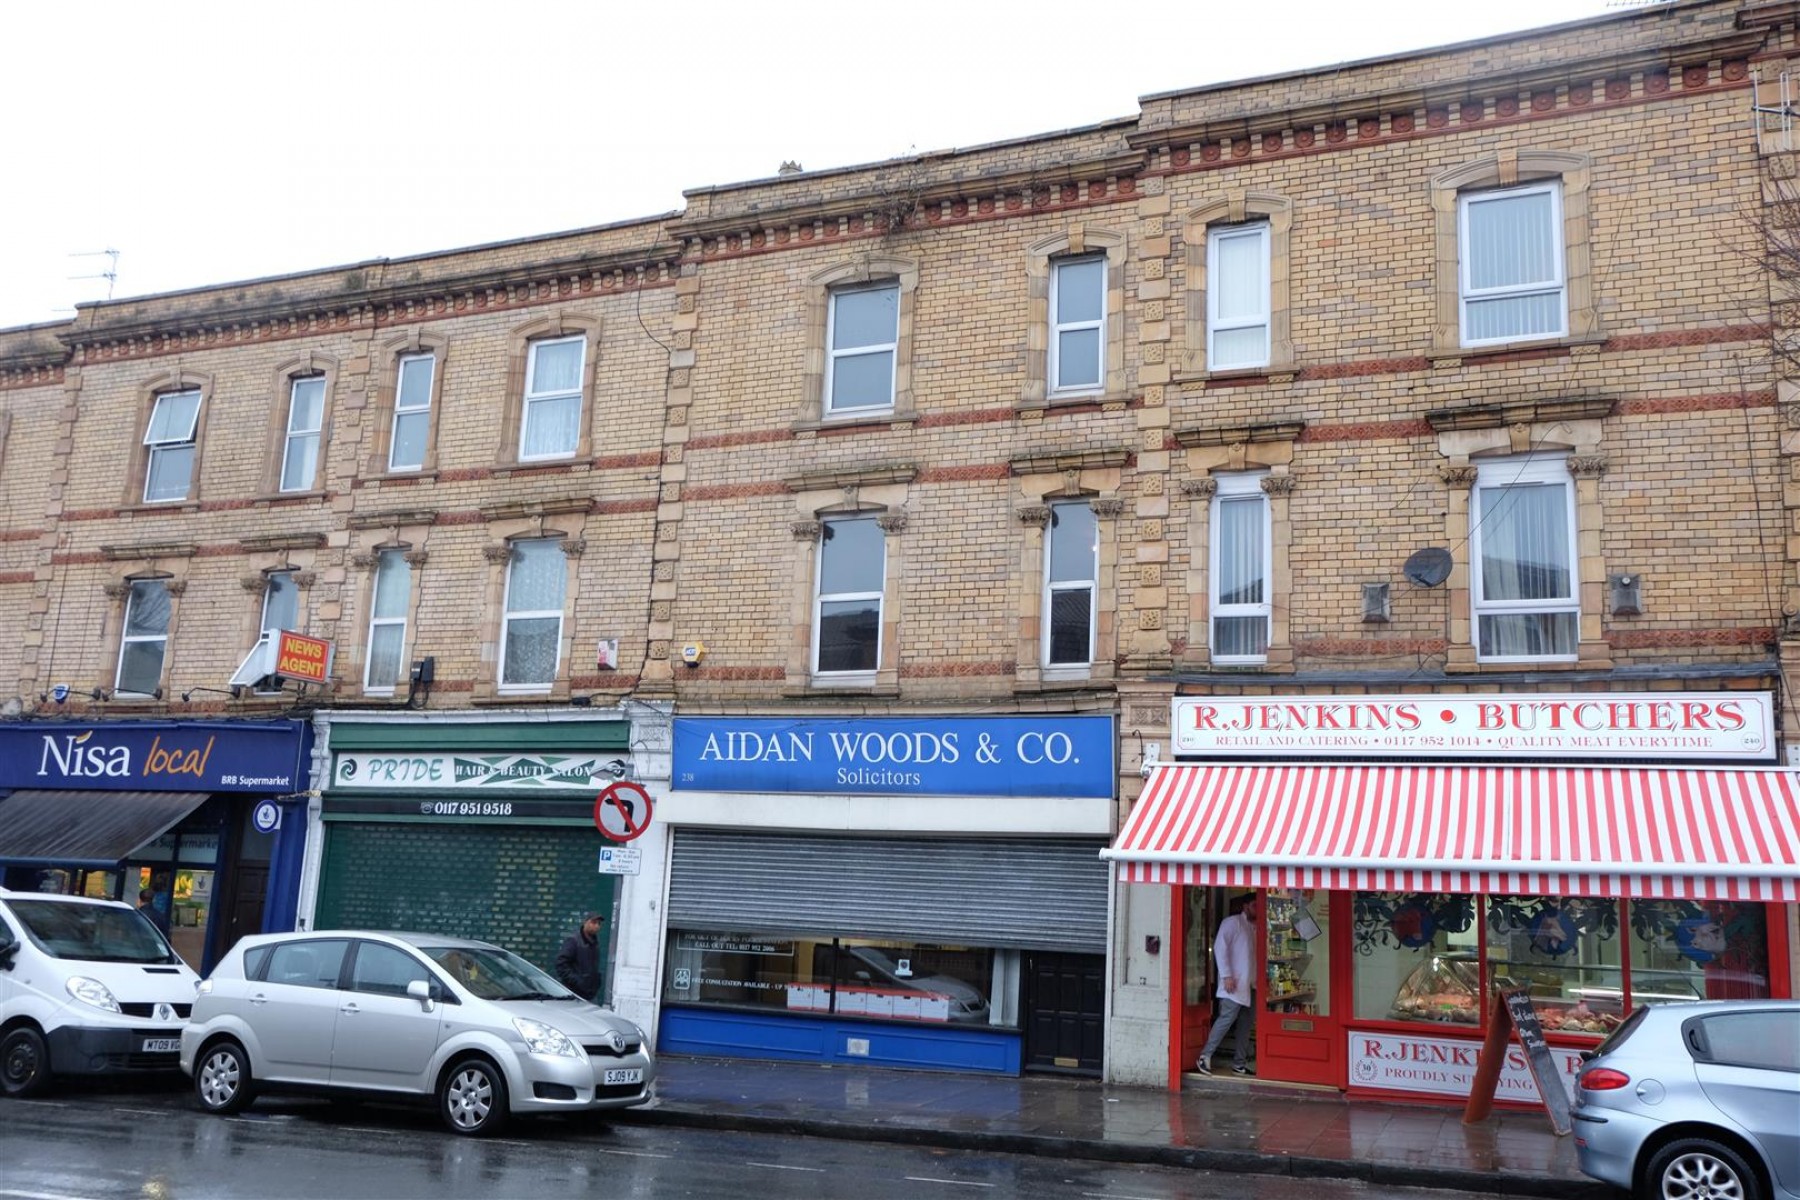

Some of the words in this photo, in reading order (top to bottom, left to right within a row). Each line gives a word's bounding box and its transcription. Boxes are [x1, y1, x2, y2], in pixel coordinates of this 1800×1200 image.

[286, 638, 322, 658] NEWS
[280, 656, 323, 677] AGENT
[1193, 704, 1421, 731] R.JENKINS
[1476, 701, 1746, 732] BUTCHERS
[699, 732, 814, 762] AIDAN
[829, 732, 960, 764] WOODS
[974, 732, 1001, 765] &
[1016, 732, 1081, 765] CO.
[1216, 736, 1262, 746] RETAIL
[1269, 736, 1294, 746] AND
[1298, 736, 1369, 746] CATERING
[1498, 736, 1563, 749] QUALITY
[1570, 737, 1613, 747] MEAT
[1619, 737, 1713, 748] EVERYTIME
[37, 730, 131, 777] Nisa
[143, 736, 215, 777] local
[368, 758, 443, 781] PRIDE
[455, 765, 485, 776] HAIR
[500, 766, 547, 777] BEAUTY
[837, 767, 920, 786] Solicitors
[221, 776, 238, 785] BRB
[239, 776, 290, 788] Supermarket
[1385, 1067, 1448, 1082] PROUDLY
